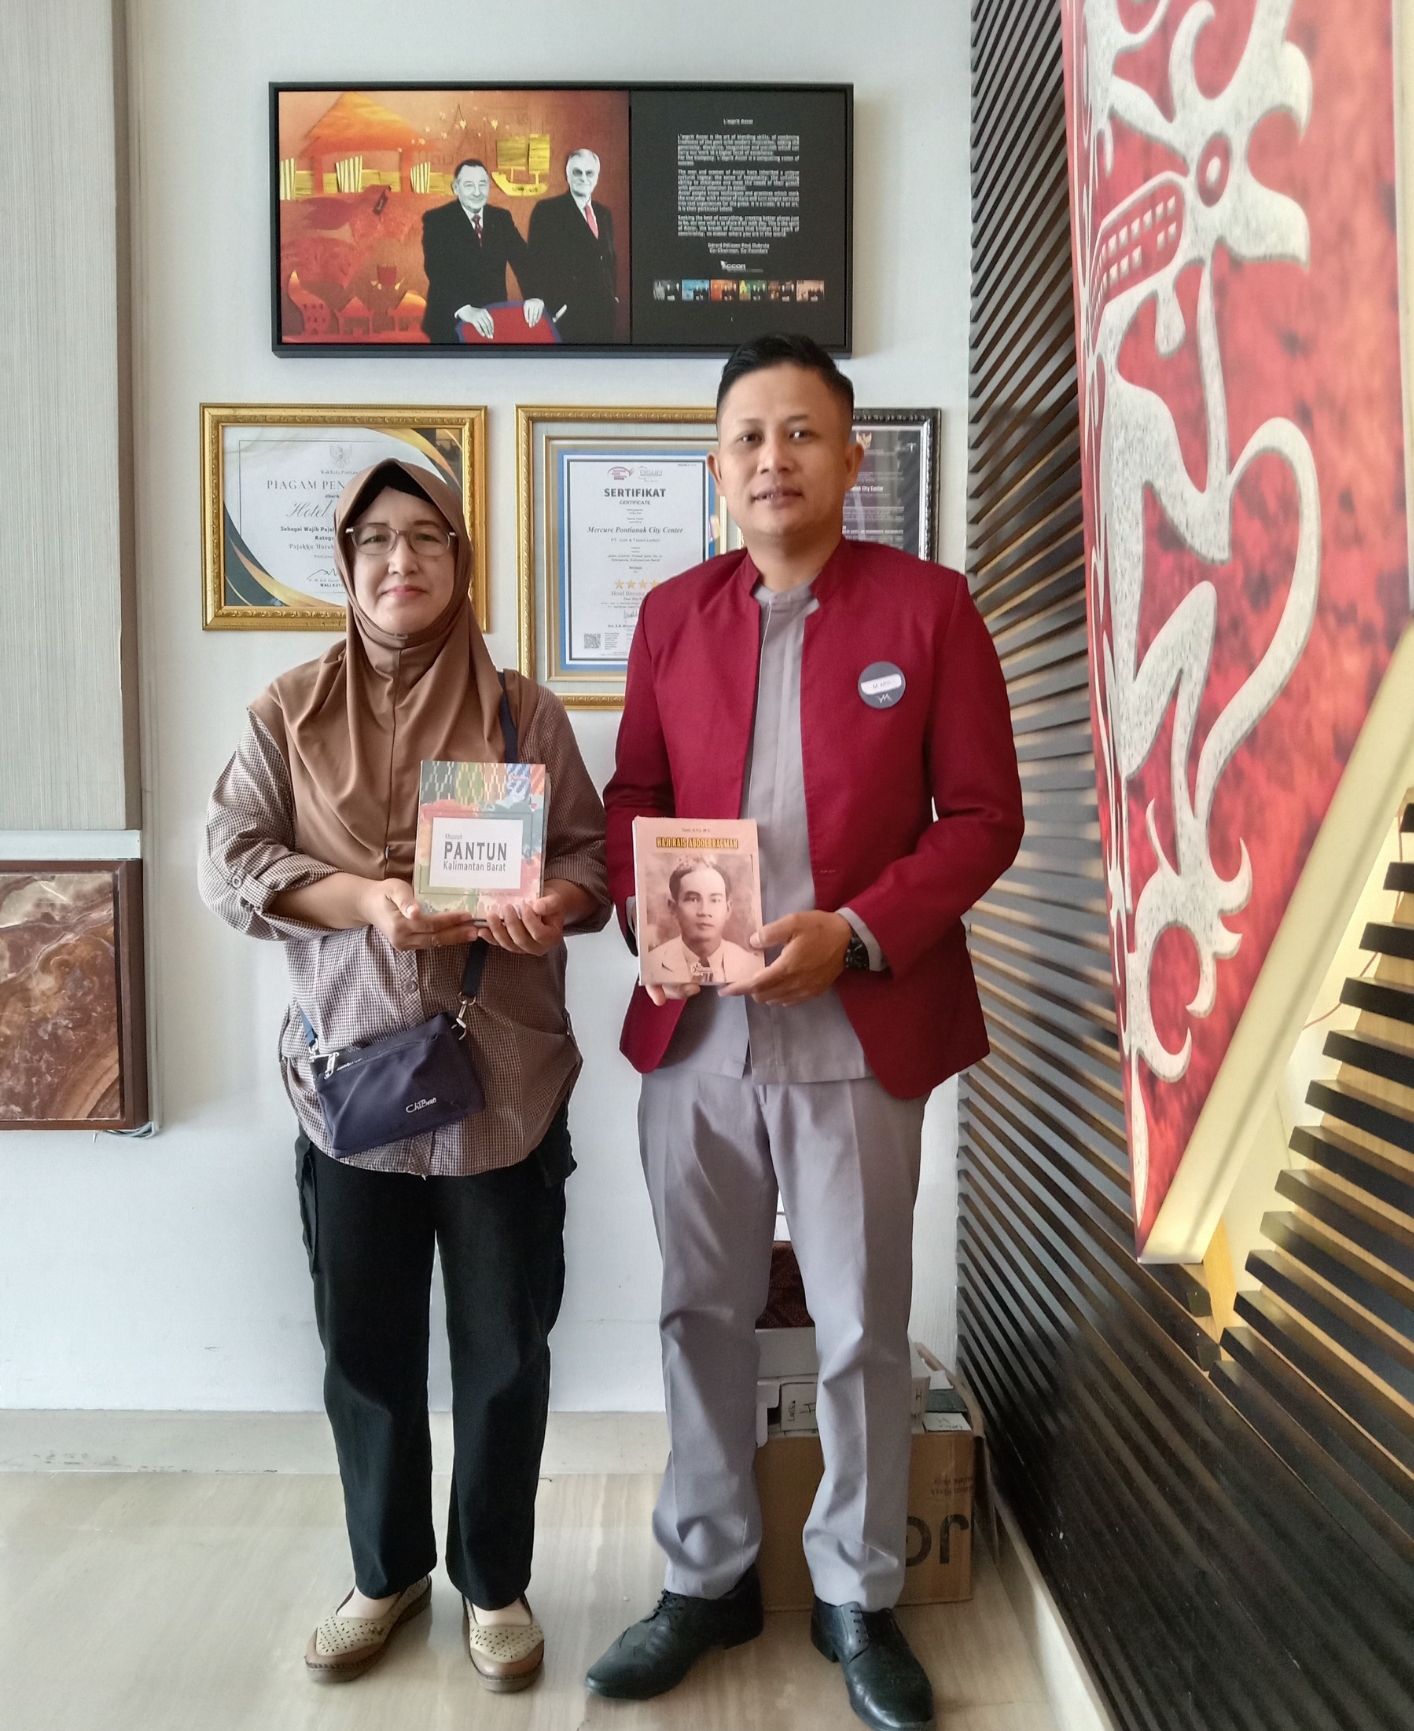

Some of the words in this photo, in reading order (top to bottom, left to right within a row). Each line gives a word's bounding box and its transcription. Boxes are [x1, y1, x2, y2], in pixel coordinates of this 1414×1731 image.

[267, 480, 316, 490] PIAGAM
[604, 488, 666, 498] SERTIFIKAT
[286, 500, 333, 518] Hotel
[648, 526, 660, 535] City
[444, 841, 507, 861] PANTUN
[443, 861, 484, 872] Kalimantan
[486, 862, 506, 872] Barat
